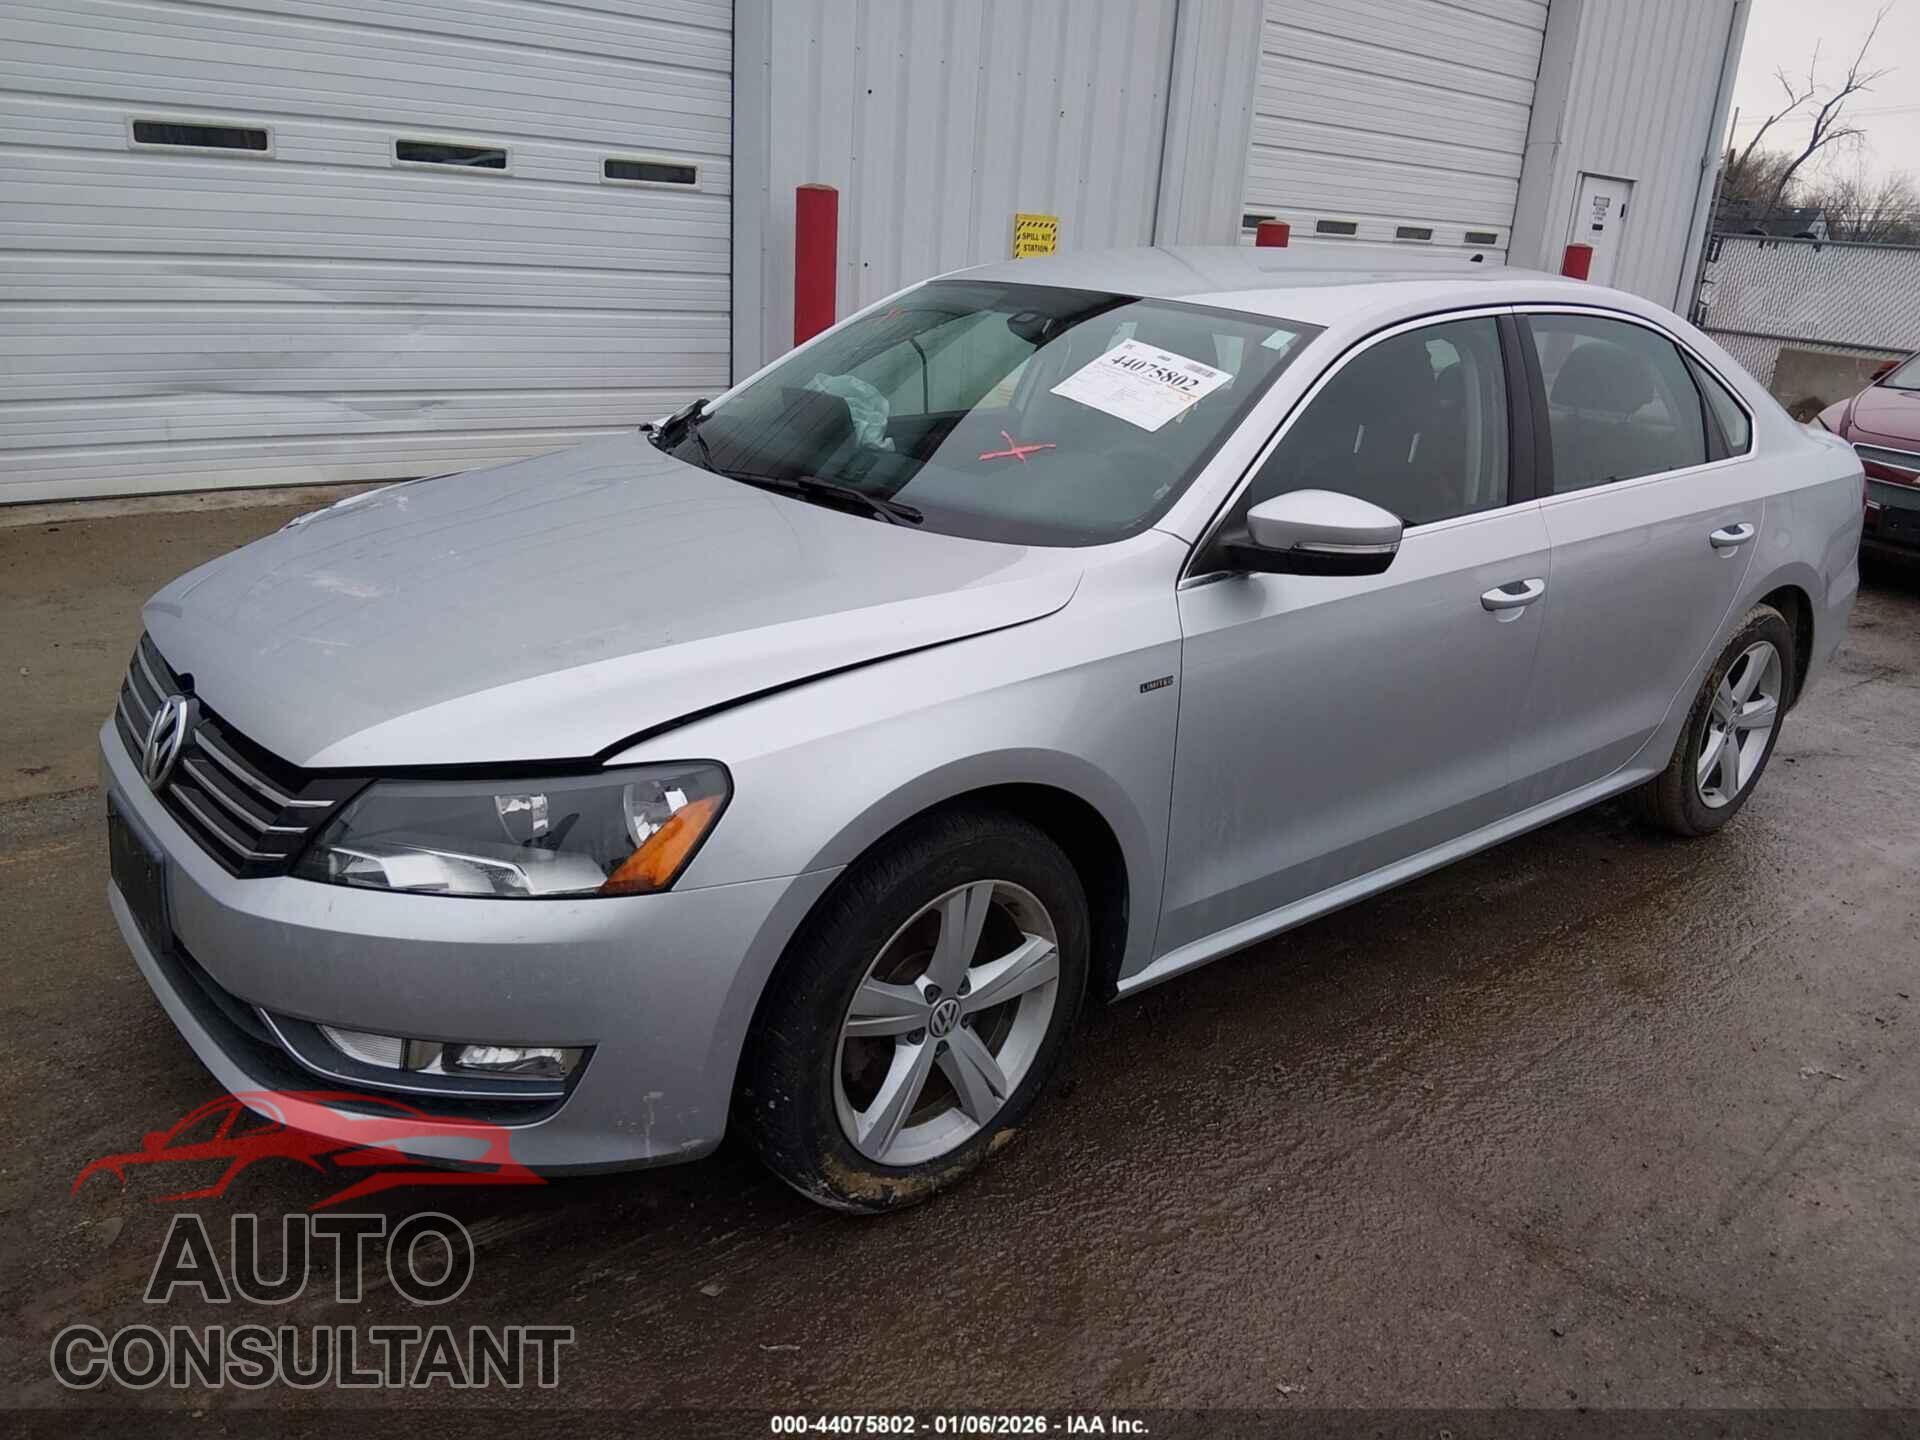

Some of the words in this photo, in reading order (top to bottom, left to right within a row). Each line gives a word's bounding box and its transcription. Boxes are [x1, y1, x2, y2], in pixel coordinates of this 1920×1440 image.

[1022, 232, 1039, 241] SPILL
[1024, 244, 1048, 252] STATION
[1111, 355, 1200, 391] 44075802
